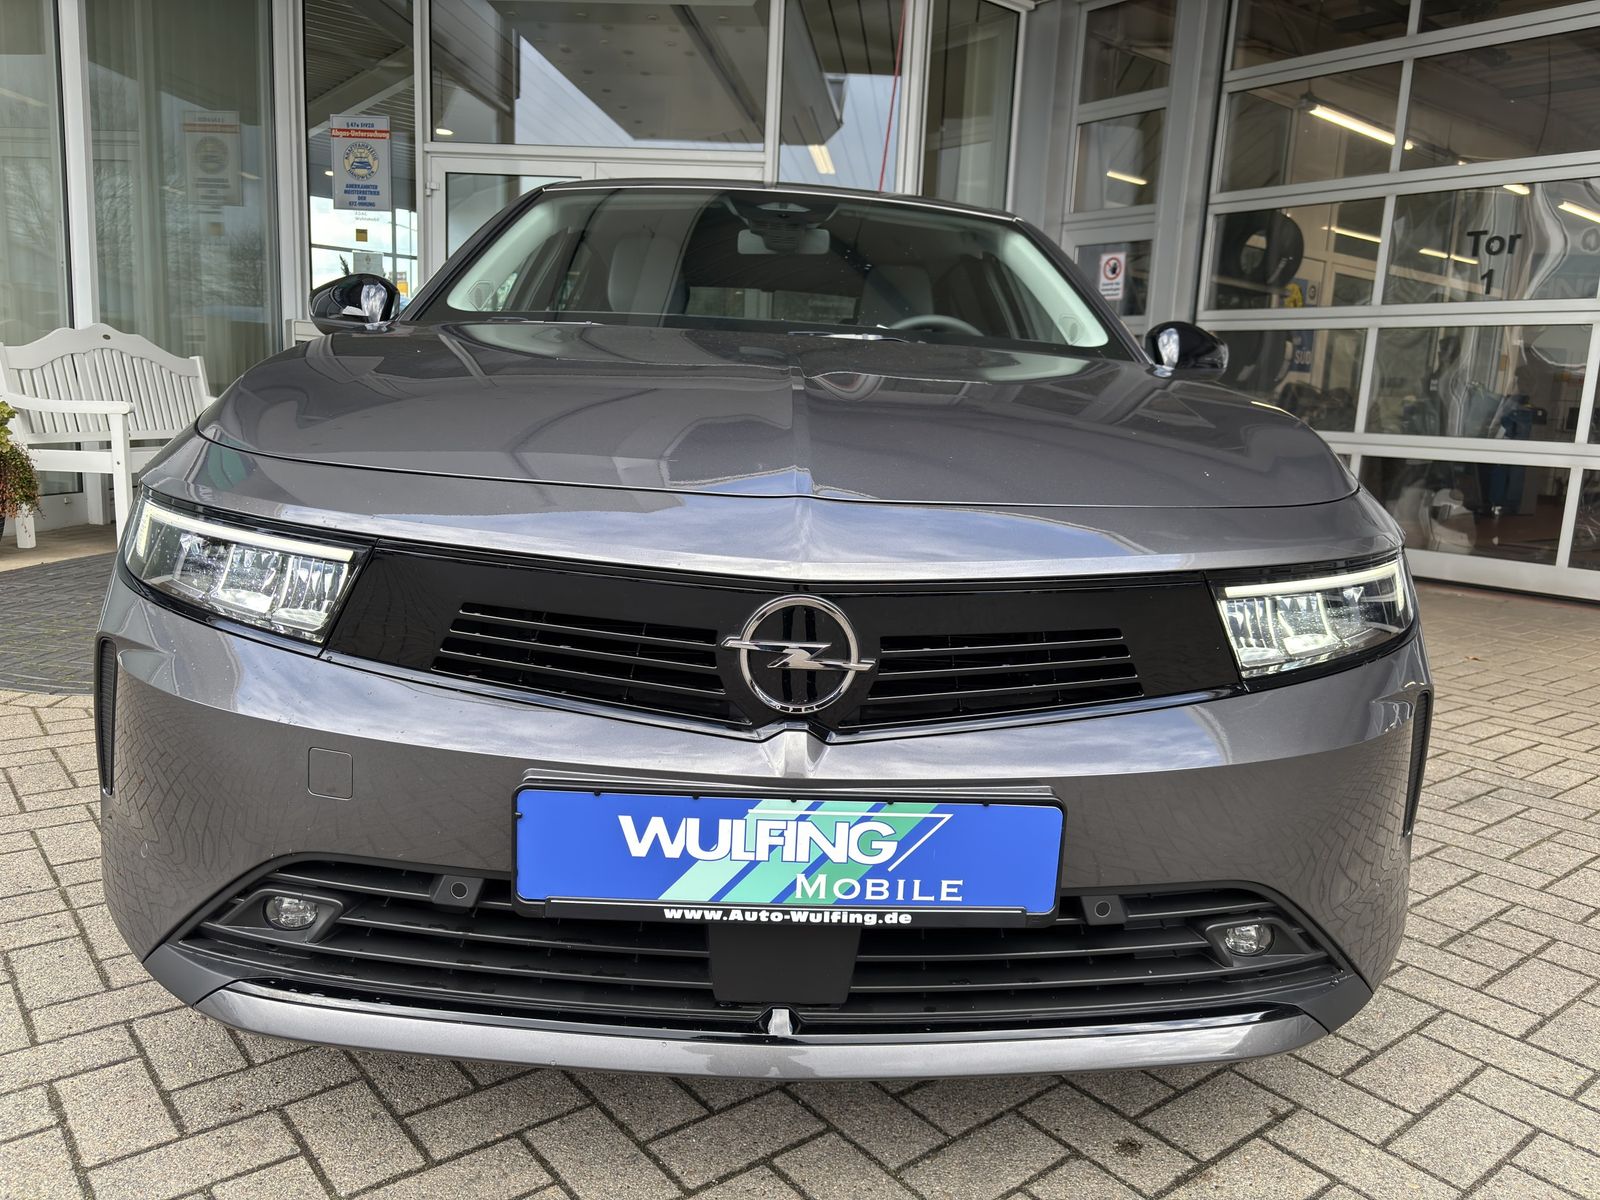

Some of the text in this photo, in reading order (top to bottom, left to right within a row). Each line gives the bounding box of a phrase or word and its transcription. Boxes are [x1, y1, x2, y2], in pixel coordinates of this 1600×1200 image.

[331, 129, 390, 139] Abgas-Untersuchung
[1466, 230, 1522, 257] Tor
[1480, 268, 1495, 295] 1
[617, 814, 899, 866] WULFING
[794, 873, 964, 902] MOBILE
[663, 908, 913, 926] www.Auto-Wulfing.de
